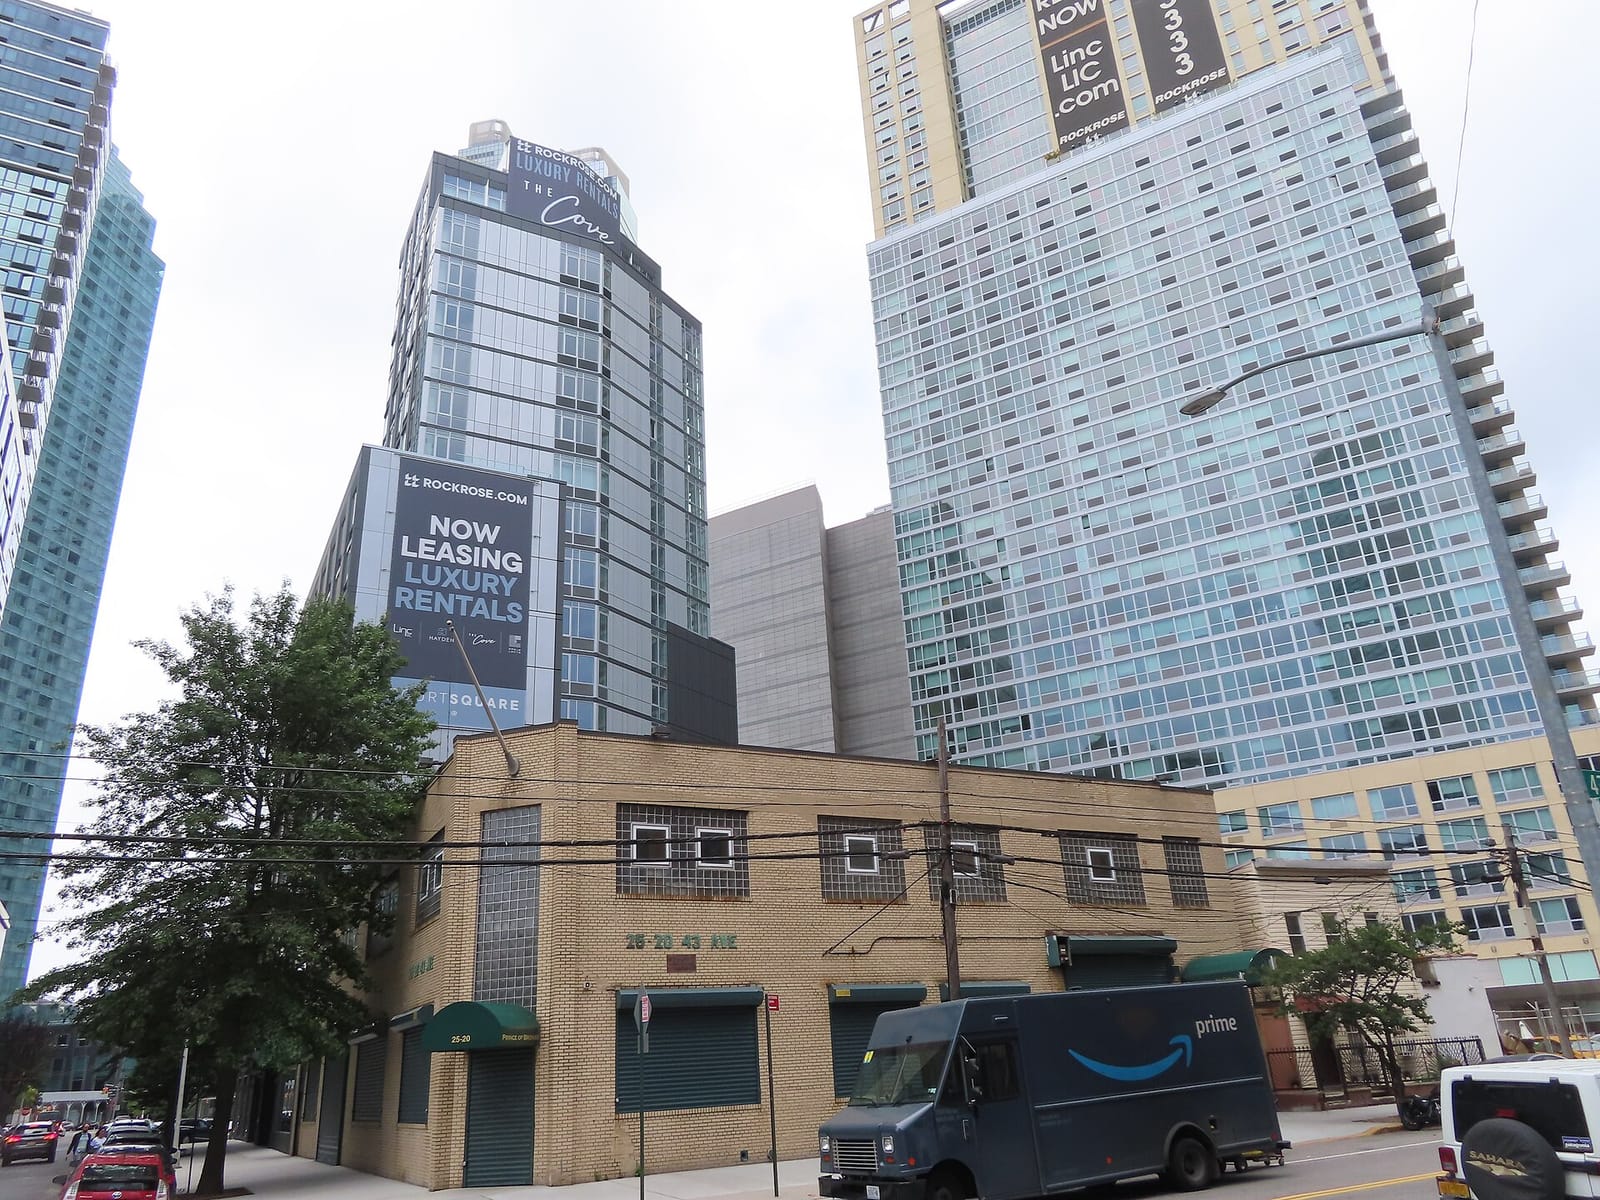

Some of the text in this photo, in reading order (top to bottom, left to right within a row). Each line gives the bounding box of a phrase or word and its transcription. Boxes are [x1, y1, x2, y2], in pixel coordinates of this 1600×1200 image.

[1039, 0, 1098, 35] NOW
[1051, 40, 1104, 73] Linc
[1061, 61, 1102, 92] LIC
[1155, 67, 1227, 104] ROCKROSE
[1055, 78, 1120, 117] .com
[1060, 111, 1126, 145] ROCKROSE
[516, 153, 618, 219] LUXURY RENTALS
[524, 180, 553, 197] THE
[535, 146, 618, 200] ROCKROSE.COM
[541, 196, 615, 244] Cove
[423, 478, 528, 505] ROCKROSE.COM
[430, 515, 501, 544] NOW
[401, 536, 523, 574] LEASING
[405, 562, 518, 596] LUXURY
[395, 587, 523, 623] RENTALS
[711, 933, 738, 949] AVE
[451, 1034, 471, 1044] 25-20
[1195, 1014, 1238, 1039] prime
